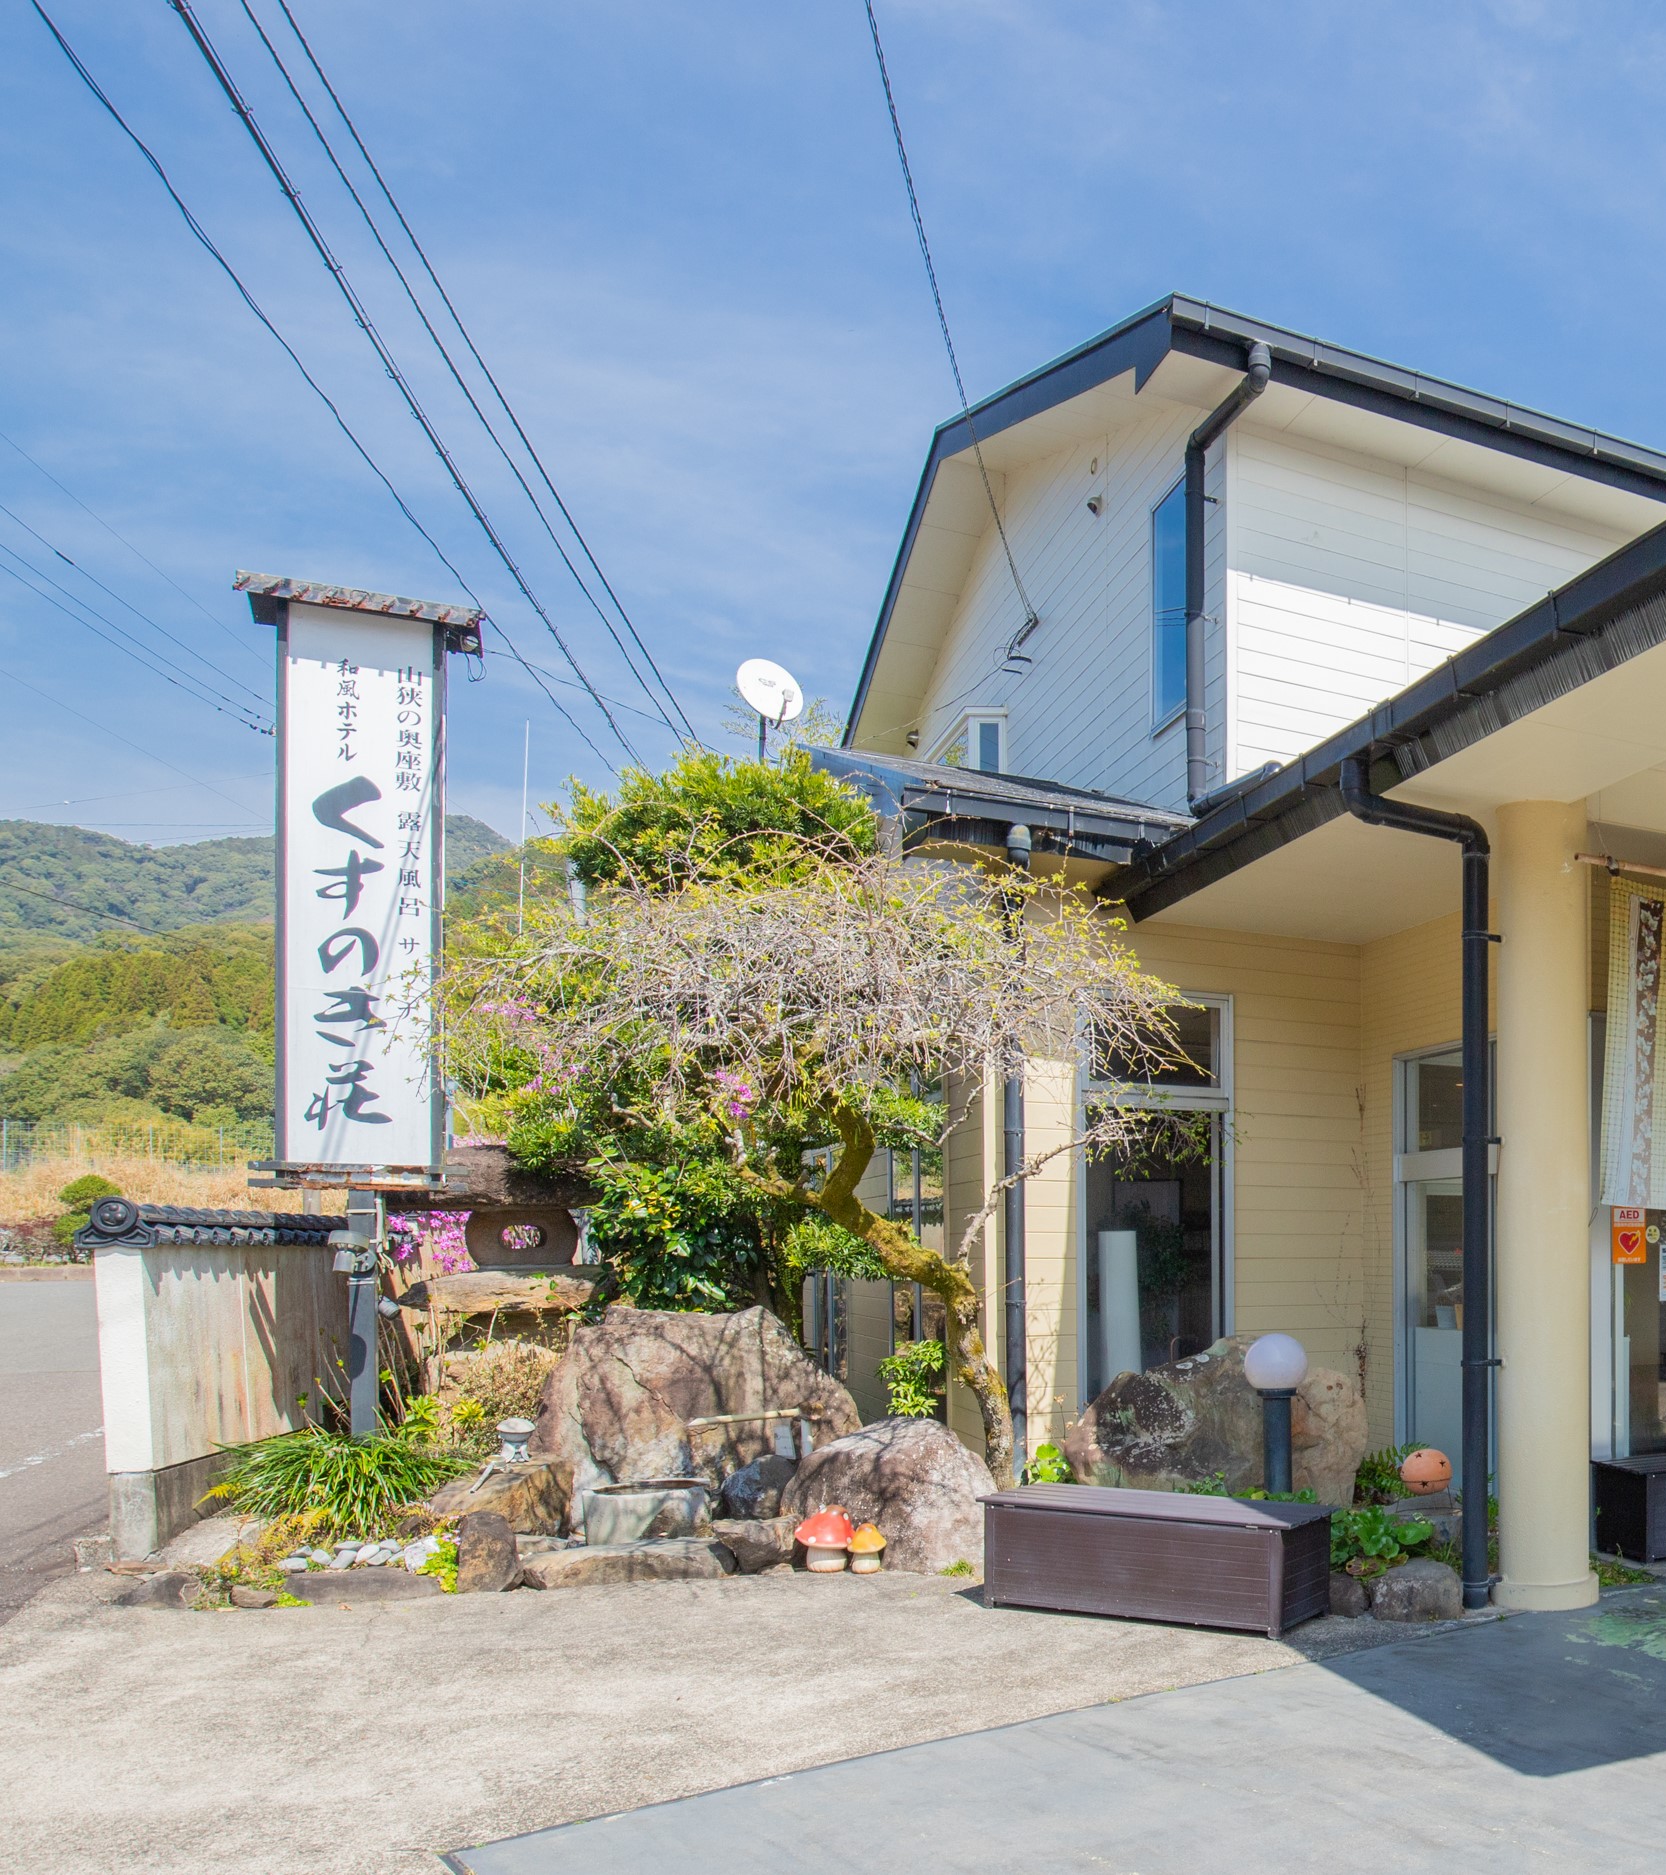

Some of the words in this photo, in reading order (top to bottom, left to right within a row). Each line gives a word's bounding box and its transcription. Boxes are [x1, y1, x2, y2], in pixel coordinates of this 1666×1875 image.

[337, 658, 359, 761] 和風ホテル
[395, 666, 422, 792] 山狭の奥座敷
[398, 811, 421, 917] 露天風呂
[304, 776, 393, 1130] くすのき荘
[1619, 1210, 1639, 1219] AED
